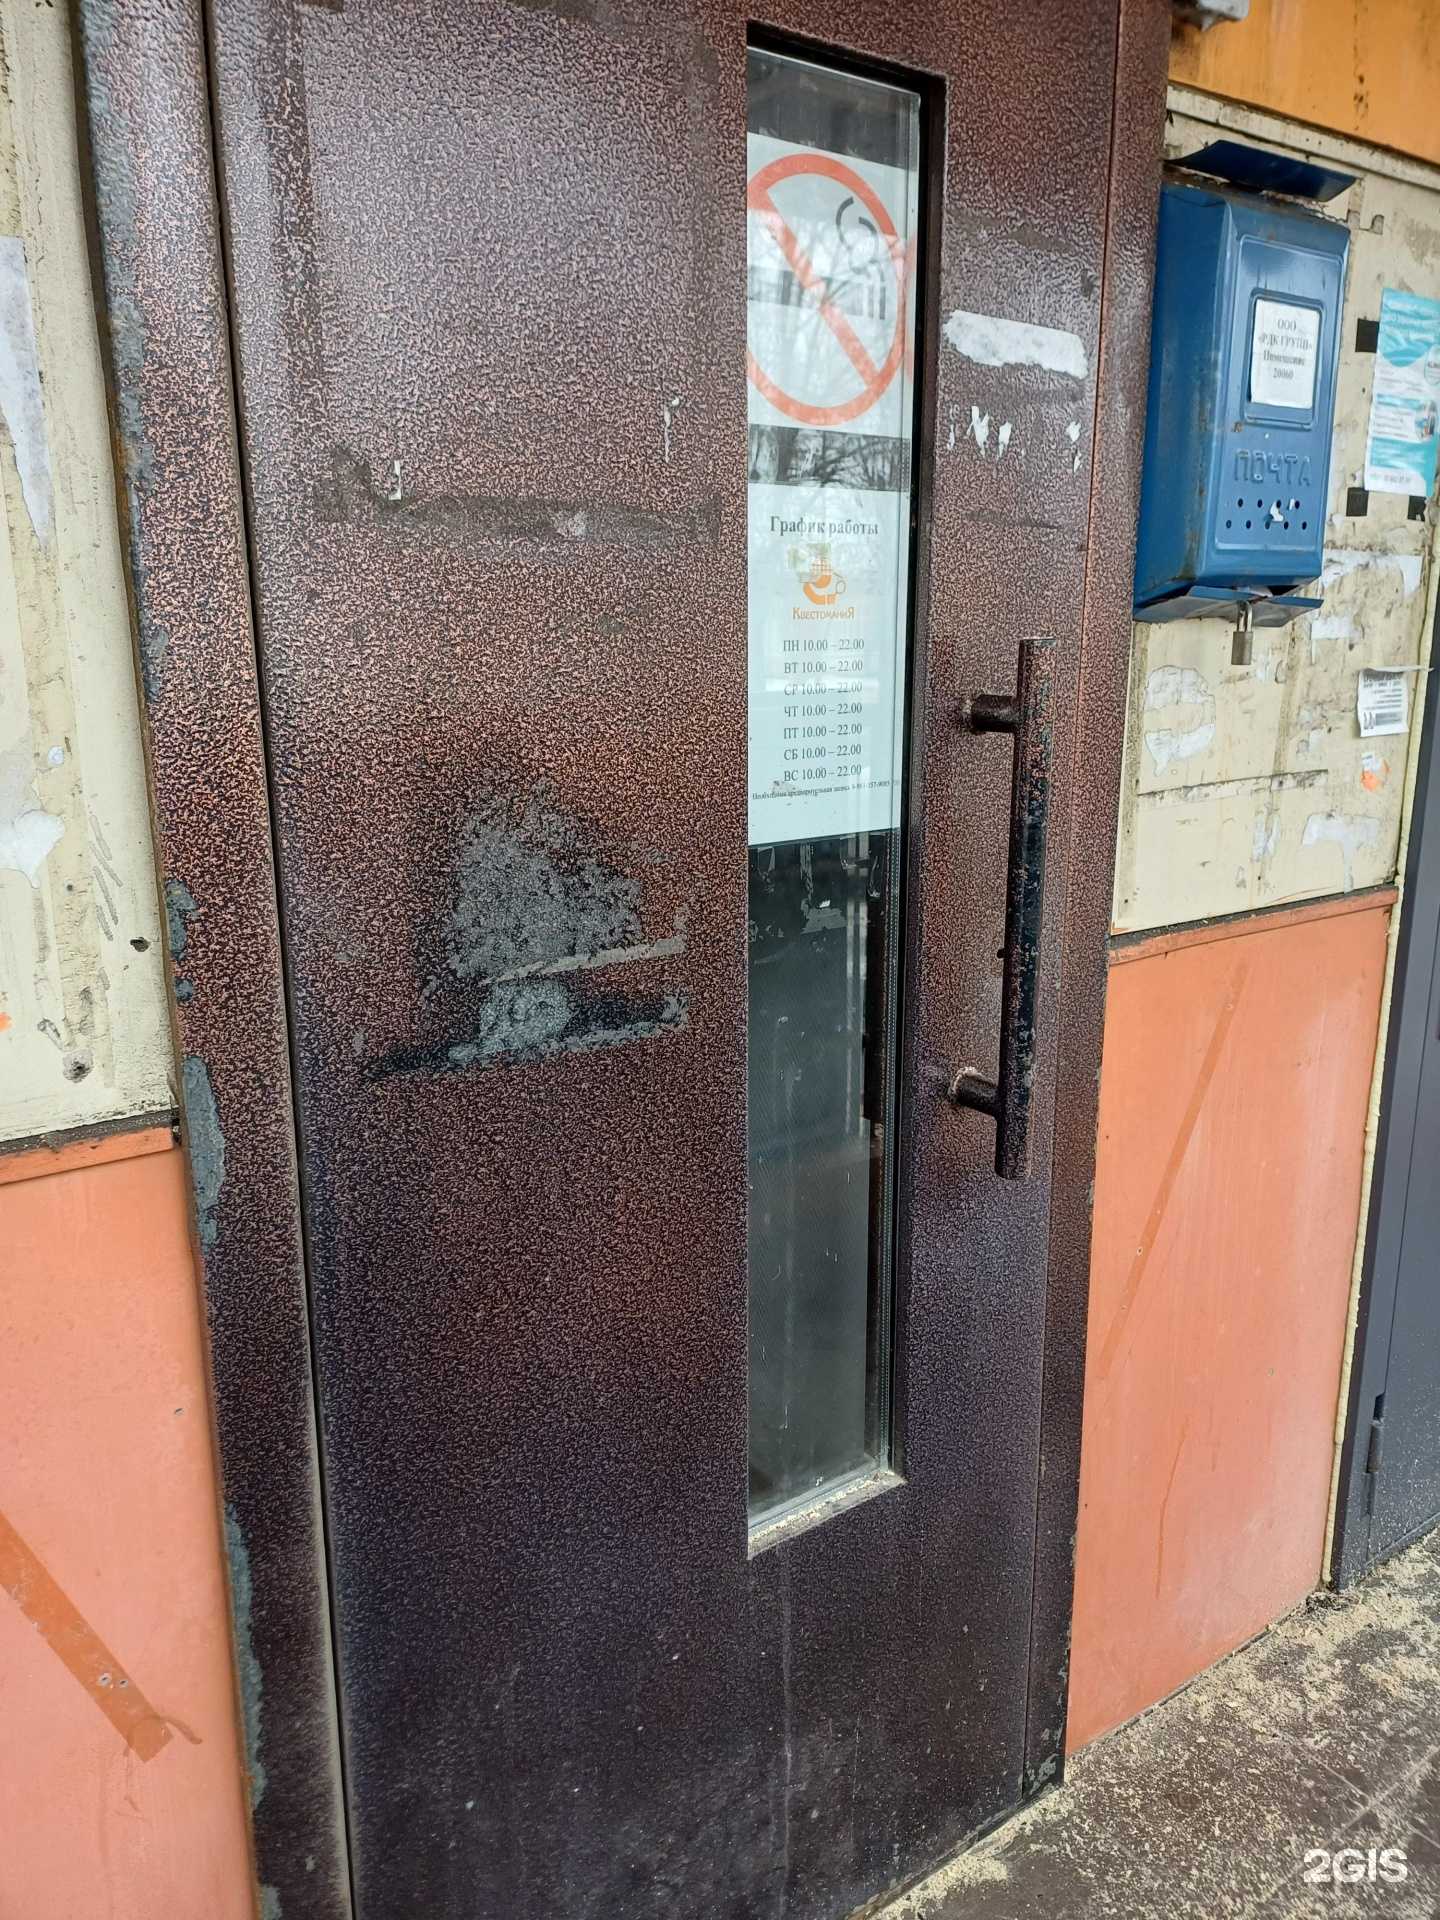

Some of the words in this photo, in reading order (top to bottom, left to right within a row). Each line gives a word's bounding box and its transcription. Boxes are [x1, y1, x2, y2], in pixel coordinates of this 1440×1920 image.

[1234, 449, 1312, 487] ПОЧТА
[770, 516, 825, 536] График
[829, 520, 879, 537] работы
[783, 640, 799, 651] ПН
[803, 639, 828, 651] 10.00
[839, 638, 864, 649] 22.00
[784, 662, 798, 673] ВТ
[803, 661, 827, 672] 10.00
[838, 660, 863, 671] 22.00
[802, 682, 827, 695] 10.00
[784, 705, 799, 717] ЧТ
[802, 704, 827, 716] 10.00
[837, 702, 862, 714] 22.00
[784, 727, 799, 739] ПТ
[802, 726, 827, 738] 10.00
[837, 723, 862, 735] 22.00
[784, 749, 798, 760] СБ
[802, 747, 826, 759] 10.00
[837, 744, 861, 756] 22.00
[784, 770, 798, 781] ВС
[802, 768, 827, 780] 10.00
[837, 764, 862, 776] 22.00
